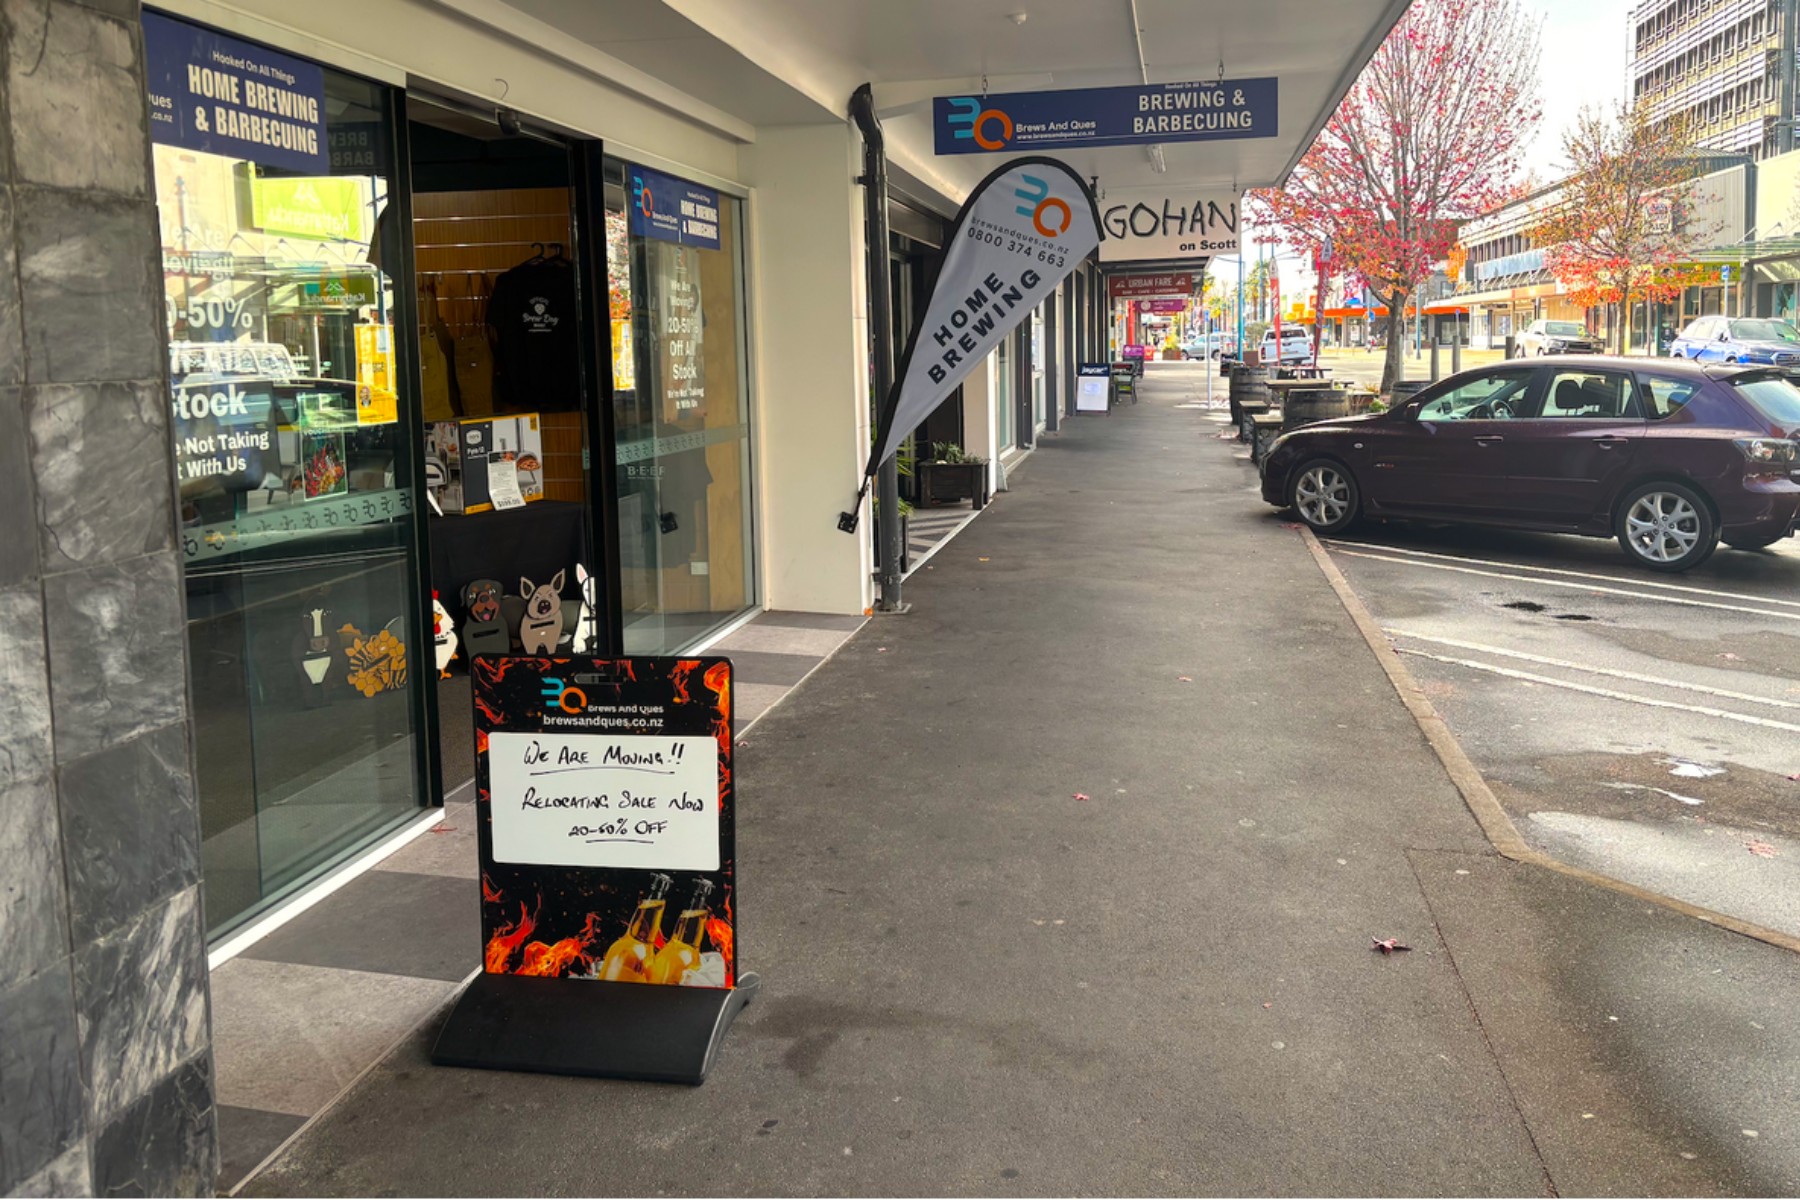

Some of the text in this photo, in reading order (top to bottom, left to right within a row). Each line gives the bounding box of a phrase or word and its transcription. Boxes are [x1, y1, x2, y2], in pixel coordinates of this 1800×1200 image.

[212, 50, 295, 86] Hooked On All Things
[188, 65, 319, 124] HOME BREWING
[1139, 89, 1246, 111] BREWING &
[195, 106, 319, 156] & BARBECUING
[1016, 120, 1096, 133] Brews And Ques
[1133, 111, 1252, 134] BARBECUING
[1103, 199, 1237, 239] GOHAN
[967, 227, 1065, 268] 0800 374 663
[971, 216, 1069, 255] brewsandques.co.nz
[1179, 239, 1237, 251] on Scott
[1155, 277, 1172, 286] FARE
[165, 295, 253, 328] 0-50%
[933, 272, 1004, 348] HOME
[927, 268, 1041, 384] BREWING
[669, 341, 683, 357] Off
[672, 363, 697, 380] Stock
[185, 436, 216, 455] Not
[217, 431, 270, 451] Taking
[186, 457, 222, 478] With
[226, 454, 247, 472] Us
[543, 714, 664, 728] brewsandques.co.nz
[587, 704, 664, 714] Brews And Ques
[522, 786, 609, 811] RELOCATING
[618, 789, 657, 809] SALE
[635, 820, 668, 835] OFF
